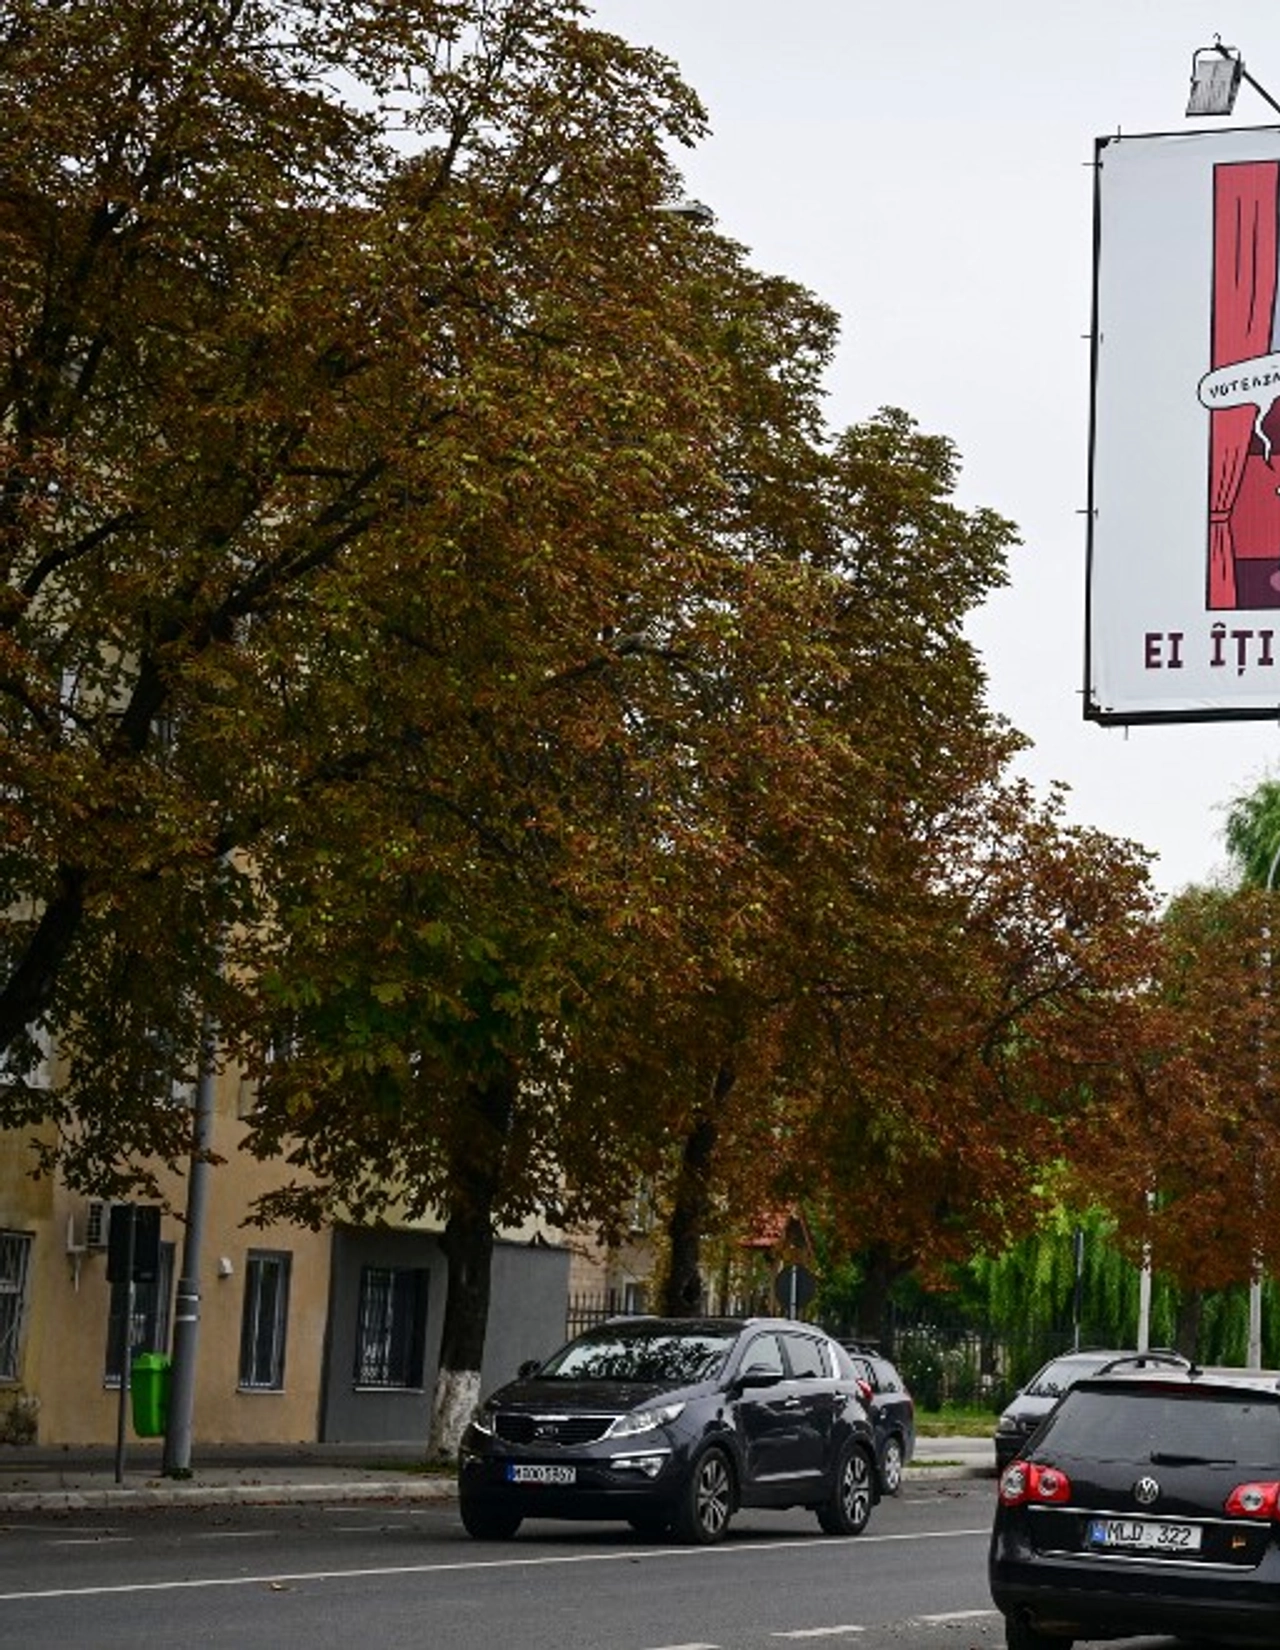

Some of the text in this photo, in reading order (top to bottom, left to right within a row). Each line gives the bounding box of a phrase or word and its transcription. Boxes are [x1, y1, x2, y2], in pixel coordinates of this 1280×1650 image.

[1144, 631, 1185, 669] EI
[1108, 1521, 1192, 1546] MLD 322
